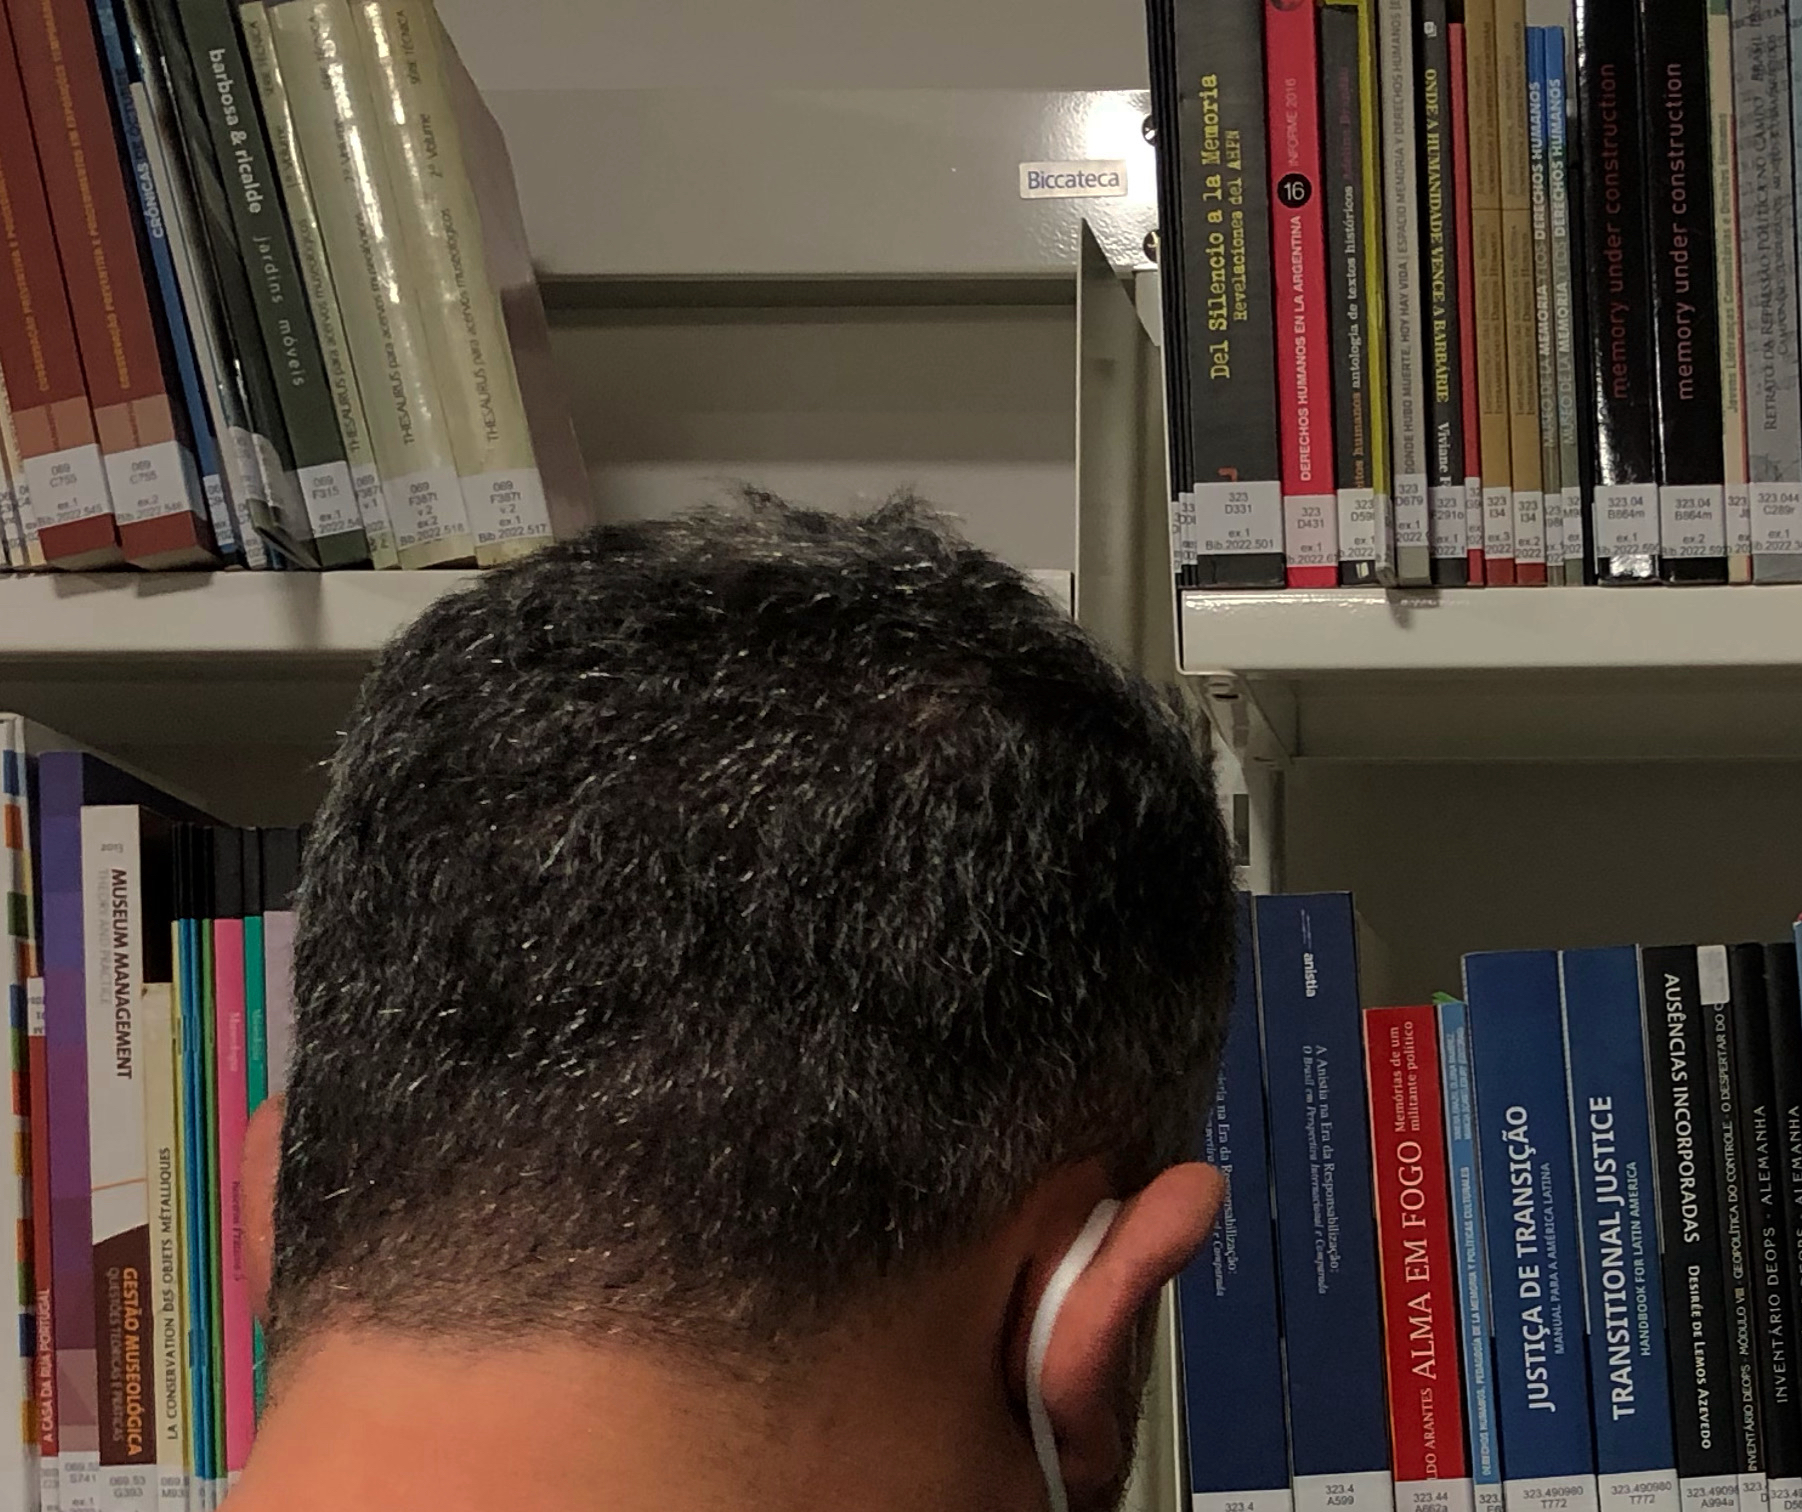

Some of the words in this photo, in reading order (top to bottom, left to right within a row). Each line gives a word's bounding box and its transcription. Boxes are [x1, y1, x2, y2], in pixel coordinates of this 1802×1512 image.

[1425, 69, 1437, 115] ONDE
[208, 49, 240, 126] barbosa
[234, 149, 262, 214] ricalde
[1198, 74, 1221, 164] Memoria
[1287, 110, 1299, 166] INFORME
[1665, 63, 1687, 214] construction
[1028, 171, 1120, 189] Biccateca
[1203, 175, 1221, 200] la
[1229, 178, 1243, 204] del
[1284, 181, 1305, 201] 16
[1426, 133, 1443, 243] HUMANIDADE
[1207, 210, 1223, 222] a
[1343, 186, 1356, 253] históricos
[1232, 211, 1247, 320] Revelaciones
[1290, 216, 1304, 292] ARGENTINA
[1345, 258, 1357, 299] textos
[1431, 248, 1445, 302] VENCE
[1670, 223, 1689, 293] under
[1206, 233, 1229, 330] Silencio
[1293, 295, 1304, 312] LA
[253, 236, 282, 303] jardins
[278, 320, 306, 386] móveis
[1294, 315, 1306, 333] EN
[1346, 304, 1359, 319] de
[1210, 340, 1231, 378] Del
[1295, 336, 1308, 403] HUMANOS
[1347, 324, 1361, 388] antologia
[1433, 320, 1450, 402] BARBÁRIE
[1675, 302, 1695, 399] memory
[1298, 408, 1312, 481] DERECHOS
[1438, 423, 1451, 472] Viviane
[1225, 504, 1252, 514] D331
[1228, 492, 1248, 502] 323
[1205, 538, 1274, 551] Bib.2022.501
[1228, 528, 1251, 538] ex.1
[111, 869, 127, 948] MUSEUM
[1303, 953, 1317, 997] anistia
[114, 952, 131, 1079] MANAGEMENT
[1390, 1027, 1399, 1047] um
[1664, 974, 1688, 1082] AUSÊNCIAS
[1316, 1046, 1327, 1054] A
[1390, 1052, 1401, 1067] de
[1404, 1021, 1418, 1070] político
[1317, 1059, 1330, 1100] Anistia
[1393, 1071, 1405, 1132] Memórias
[1406, 1075, 1420, 1131] militante
[1320, 1104, 1330, 1118] na
[1321, 1122, 1332, 1141] Era
[1323, 1145, 1334, 1159] da
[1589, 1096, 1625, 1206] JUSTICE
[1672, 1087, 1700, 1243] INCORPORADAS
[160, 1148, 172, 1233] MÉTALLIQUES
[1397, 1141, 1426, 1229] FOGO
[1503, 1105, 1537, 1258] TRANSIÇÃO
[1541, 1163, 1553, 1204] LATINA
[1626, 1162, 1640, 1217] AMERICA
[1323, 1163, 1340, 1273] Responsabilização:
[1542, 1207, 1557, 1258] AMÉRICA
[1629, 1221, 1643, 1255] LATIN
[161, 1239, 173, 1283] OBJETS
[1406, 1239, 1429, 1282] EM
[1519, 1265, 1541, 1297] DE
[1634, 1259, 1645, 1282] FOR
[123, 1268, 142, 1331] GESTÃO
[162, 1289, 174, 1312] DES
[1548, 1273, 1560, 1302] PARA
[1688, 1265, 1702, 1318] DESIRÉE
[1408, 1292, 1437, 1379] ALMA
[1550, 1305, 1564, 1354] MANUAL
[1599, 1212, 1636, 1420] TRANSITIONAL
[1635, 1286, 1651, 1356] HANDBOOK
[1692, 1321, 1703, 1338] DE
[164, 1318, 177, 1418] CONSERVATION
[1524, 1305, 1555, 1412] JUSTIÇA
[1693, 1341, 1707, 1385] LEMOS
[125, 1335, 145, 1455] MUSEOLÓGICA
[1421, 1388, 1436, 1449] ARANTES
[1698, 1389, 1712, 1449] AZEVEDO
[167, 1425, 178, 1439] LA
[1611, 1483, 1672, 1497] 323.490980
[1630, 1494, 1655, 1506] T772
